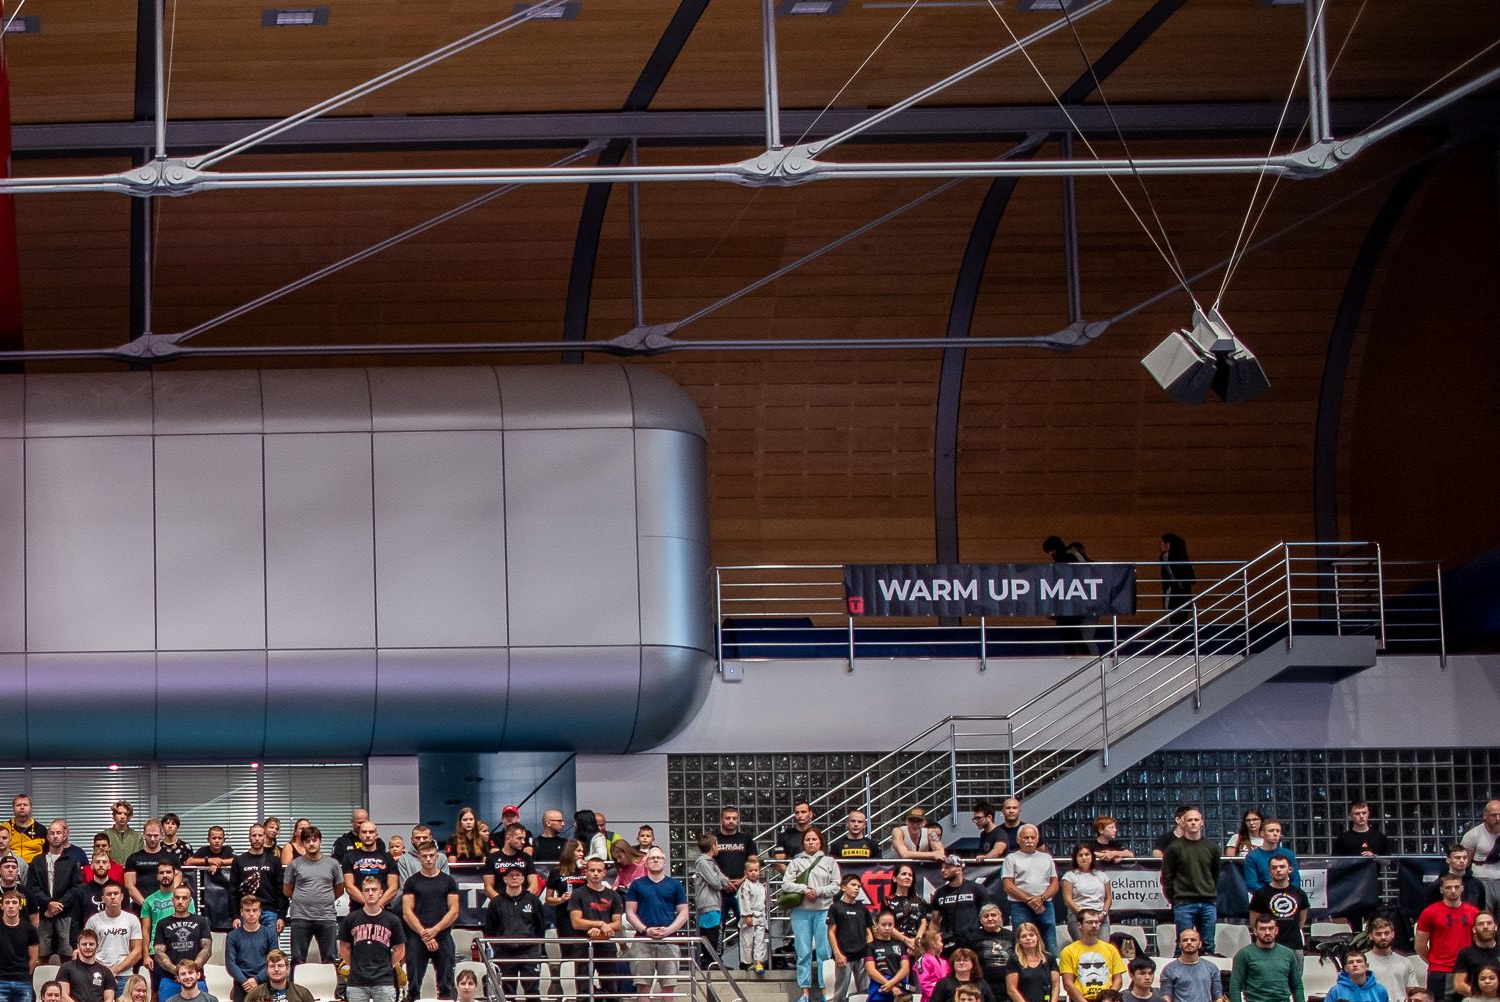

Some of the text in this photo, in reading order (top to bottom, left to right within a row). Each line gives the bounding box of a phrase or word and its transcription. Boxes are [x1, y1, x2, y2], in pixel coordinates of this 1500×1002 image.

[878, 578, 1103, 601] WARM UP MAT
[1111, 877, 1159, 888] eklamni
[1112, 891, 1160, 902] lachty.cz
